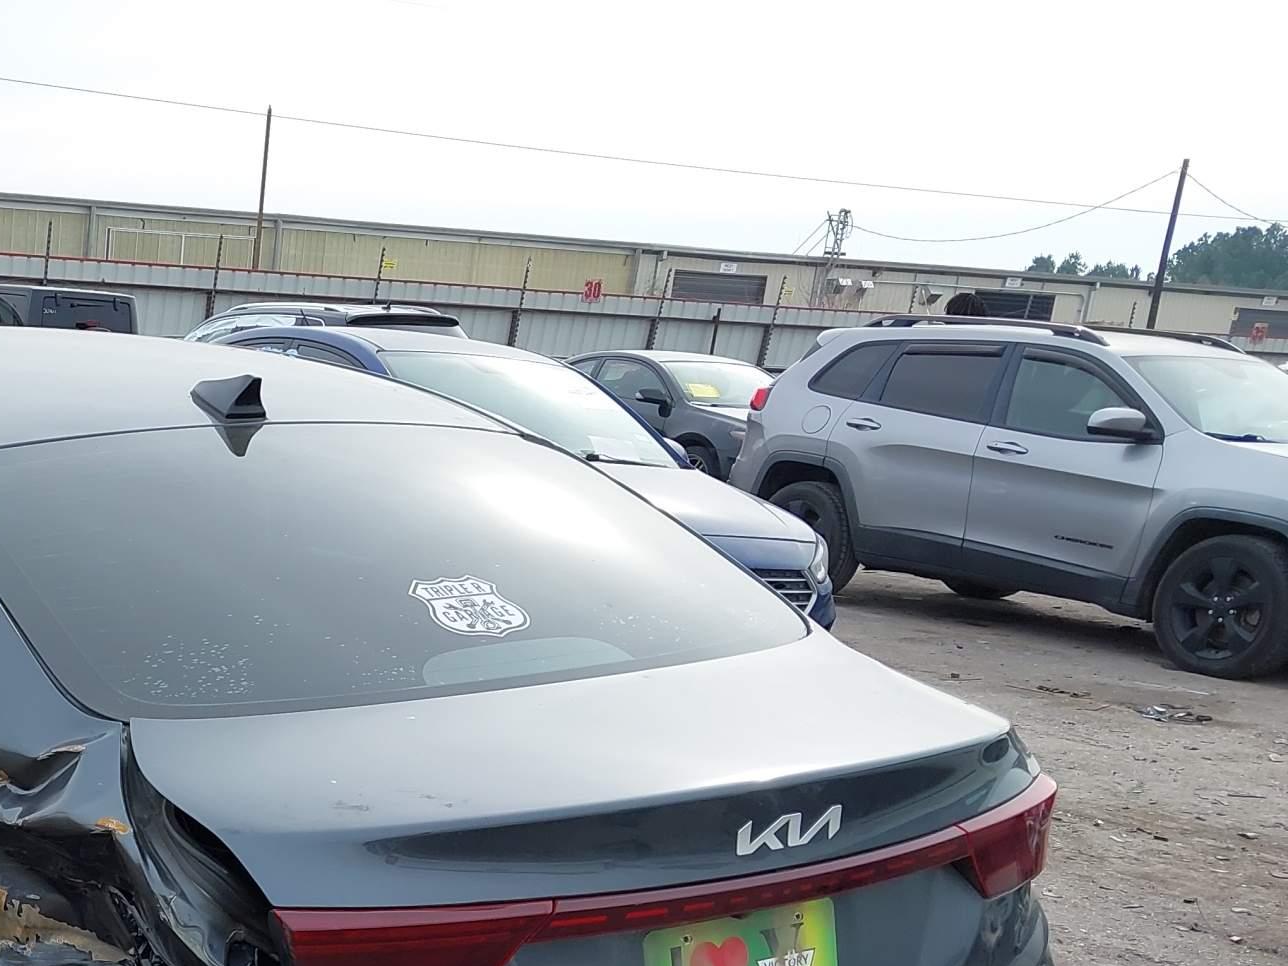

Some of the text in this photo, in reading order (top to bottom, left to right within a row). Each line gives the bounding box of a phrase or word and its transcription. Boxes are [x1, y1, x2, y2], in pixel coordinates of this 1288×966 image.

[584, 280, 602, 299] 30
[420, 583, 470, 598] TRIPLE
[443, 605, 516, 623] GARAGE
[737, 804, 842, 856] KIA
